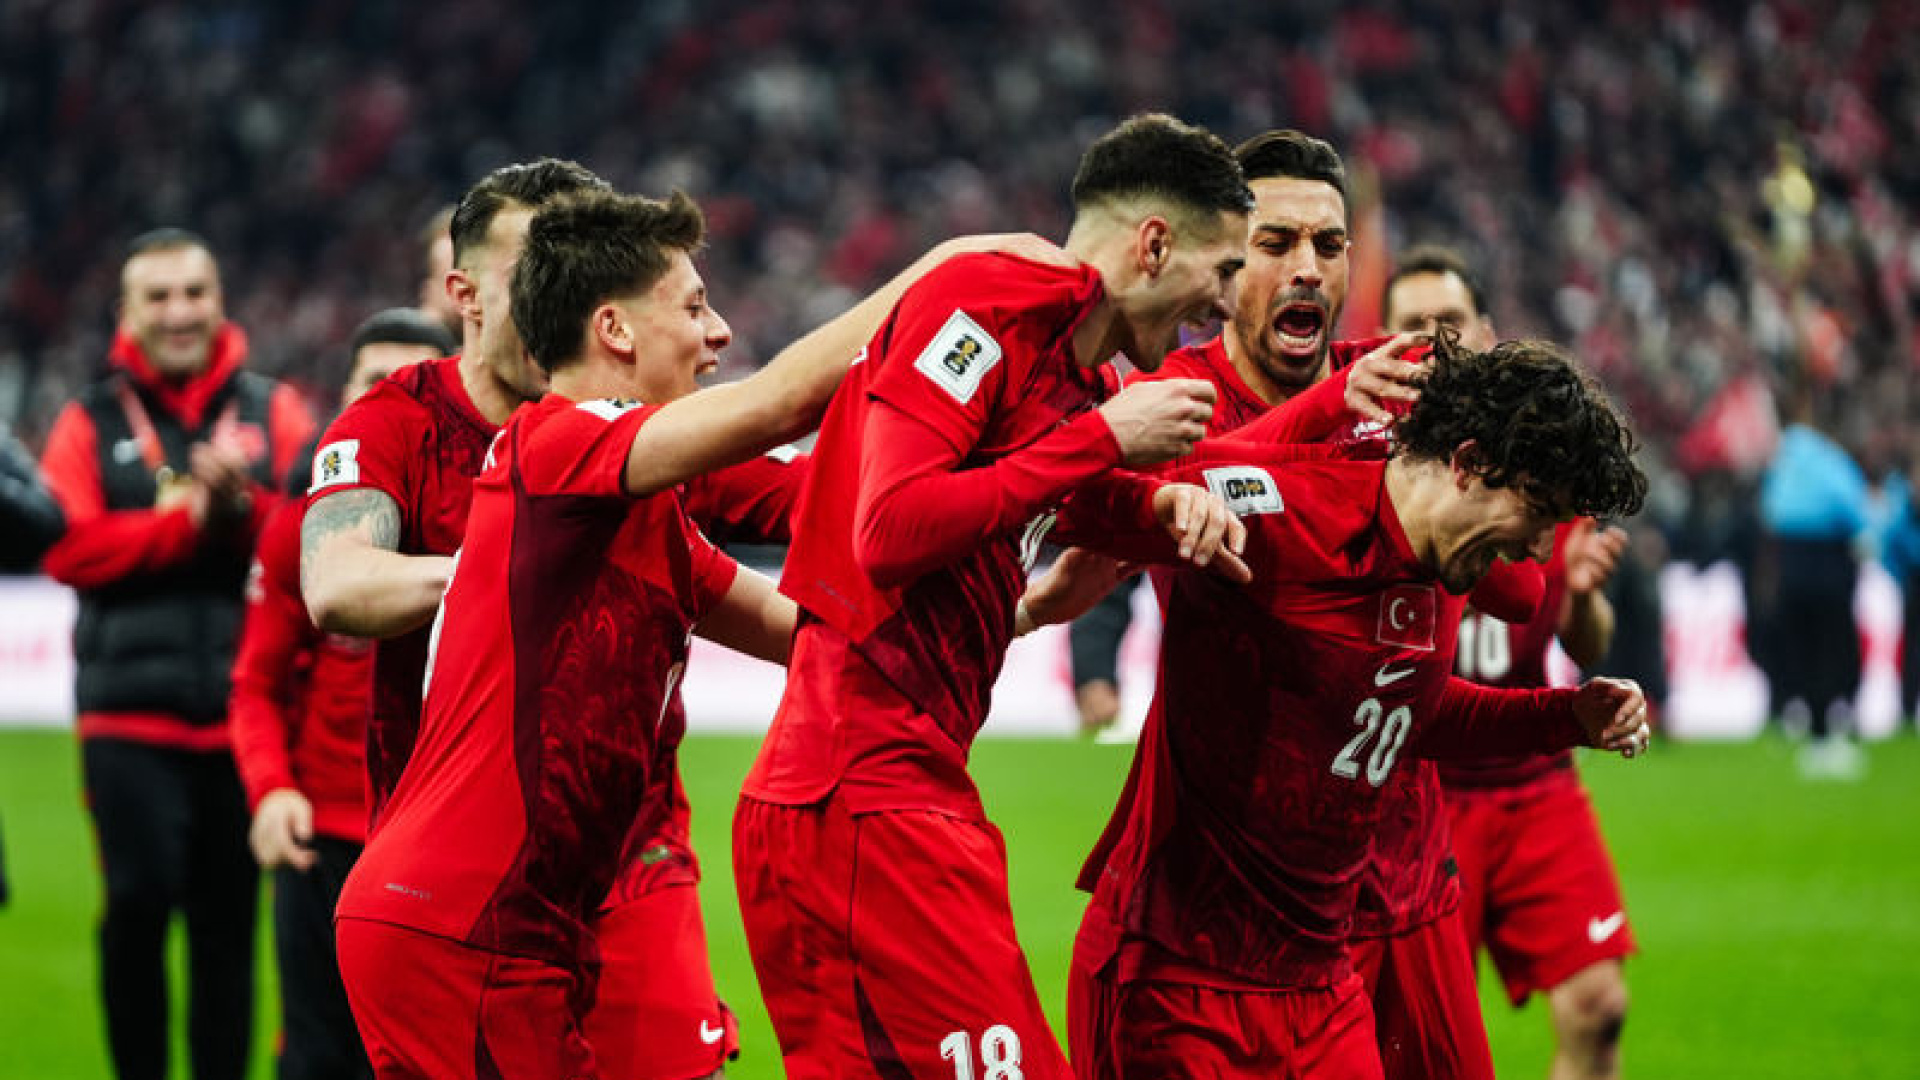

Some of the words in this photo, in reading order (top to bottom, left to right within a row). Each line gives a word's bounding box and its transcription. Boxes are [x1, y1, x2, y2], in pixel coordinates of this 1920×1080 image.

[1459, 613, 1511, 678] 10
[1330, 698, 1412, 787] 20
[940, 1025, 1025, 1080] 18
